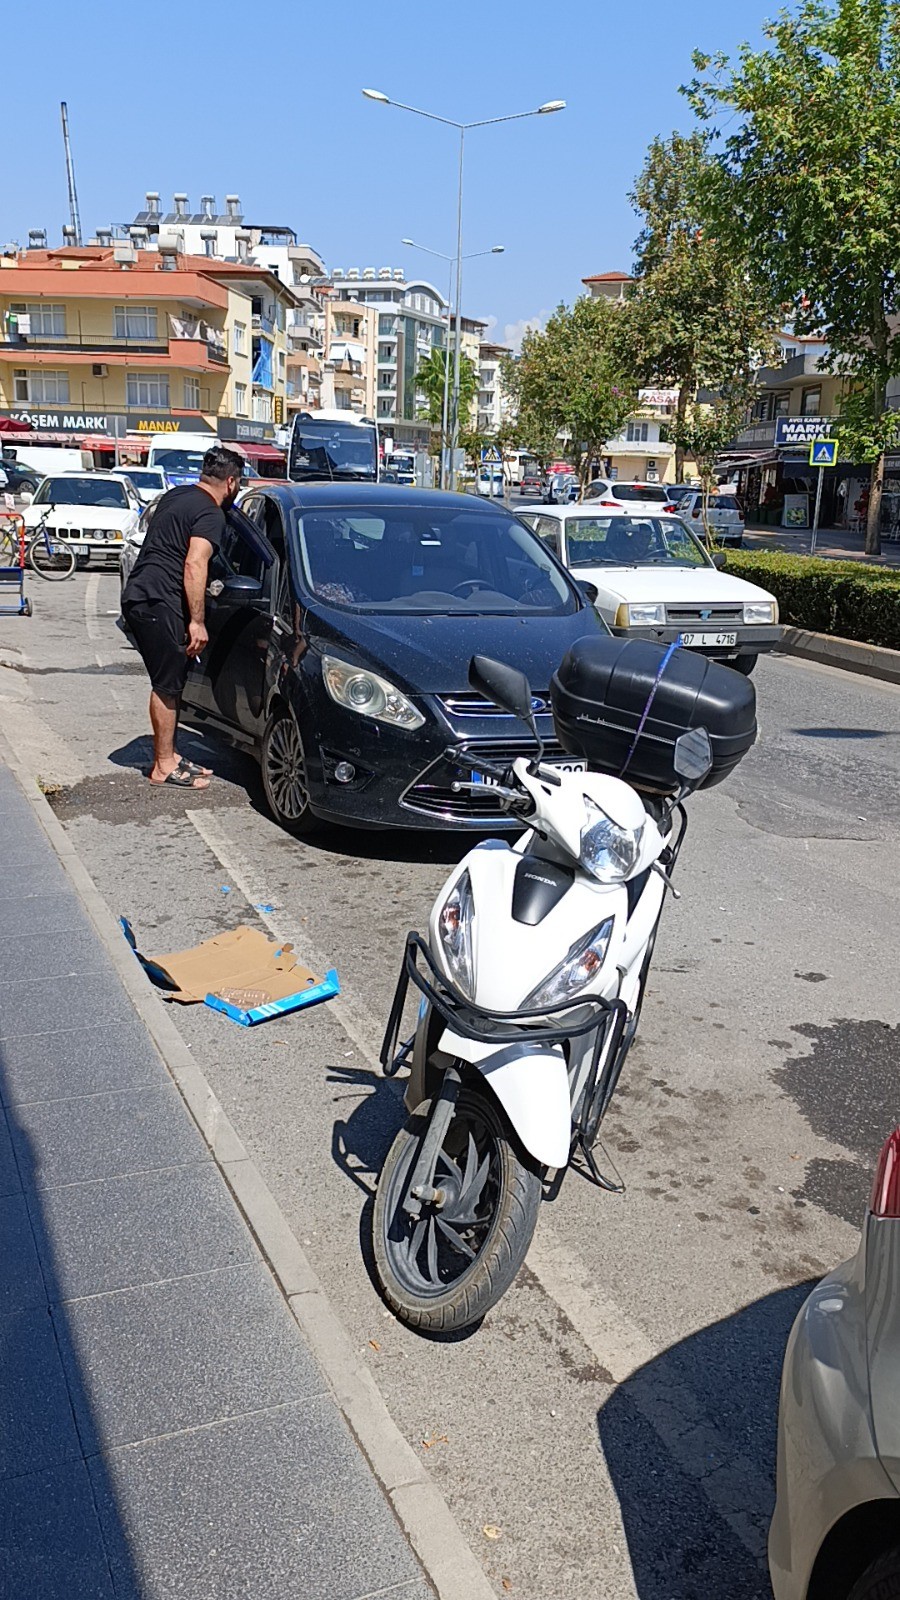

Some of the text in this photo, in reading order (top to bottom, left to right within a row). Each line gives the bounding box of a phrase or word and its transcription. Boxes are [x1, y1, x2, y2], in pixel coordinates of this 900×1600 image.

[138, 420, 180, 432] MANAV
[786, 433, 830, 441] MANA
[683, 634, 735, 645] 07 L 4716
[524, 872, 557, 887] HONDA
